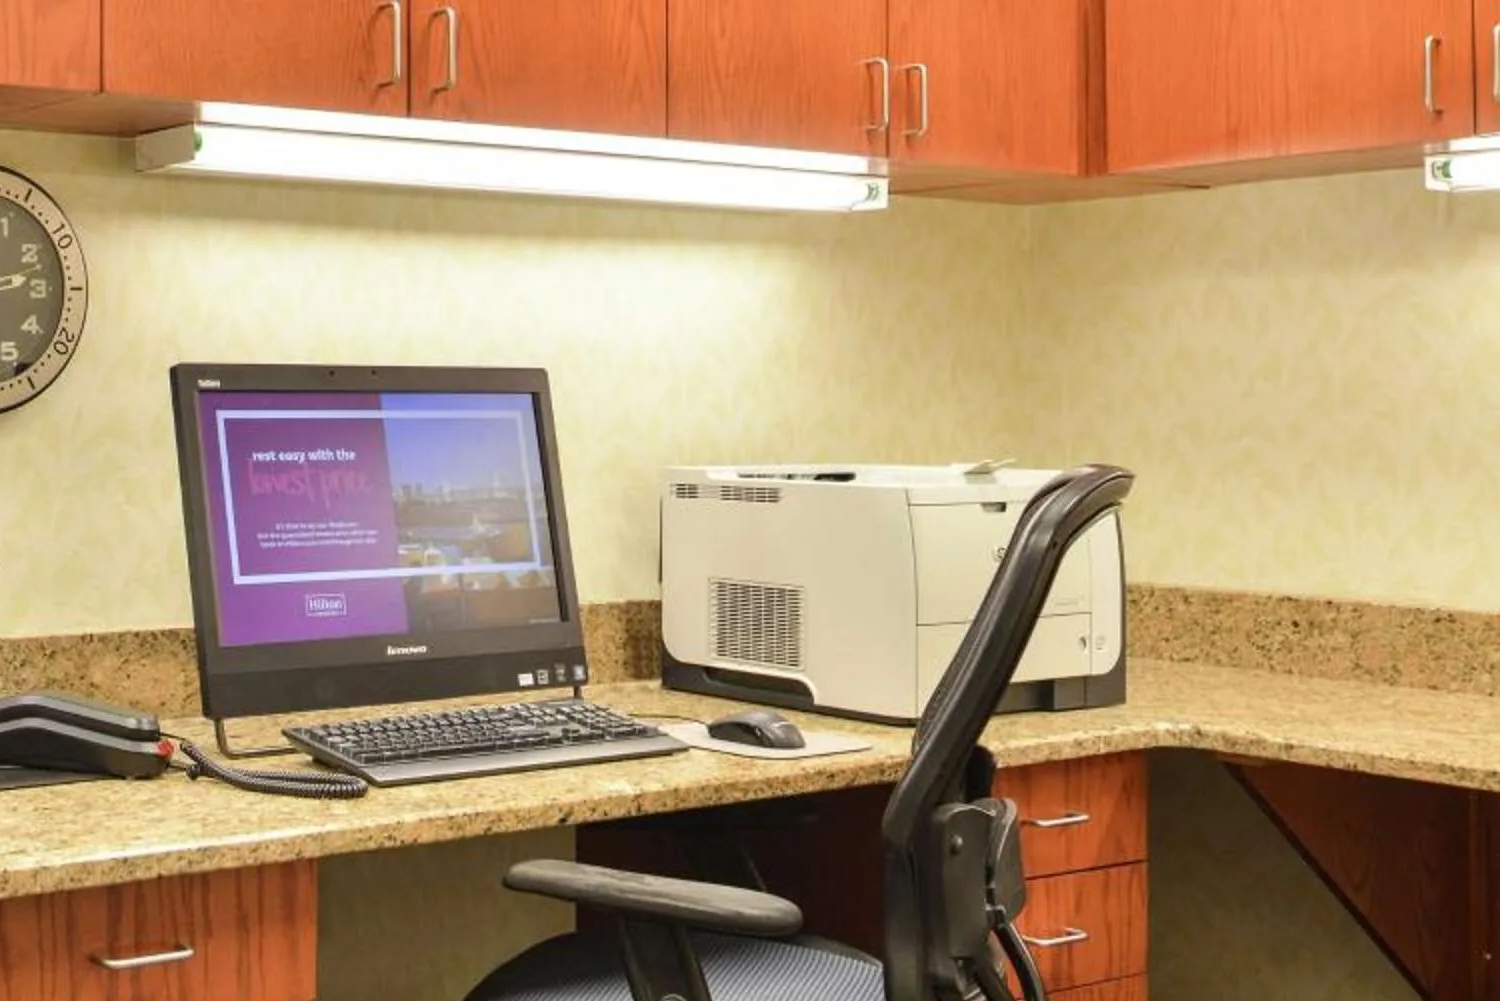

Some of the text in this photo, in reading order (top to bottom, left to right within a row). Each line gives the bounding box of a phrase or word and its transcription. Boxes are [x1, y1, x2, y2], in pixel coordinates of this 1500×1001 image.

[0, 217, 10, 238] 1
[52, 222, 74, 250] 10
[21, 243, 39, 263] 2
[29, 279, 47, 299] 3
[20, 315, 41, 335] 4
[0, 341, 18, 361] 5
[53, 327, 75, 355] 20
[252, 448, 356, 464] rest easy with the
